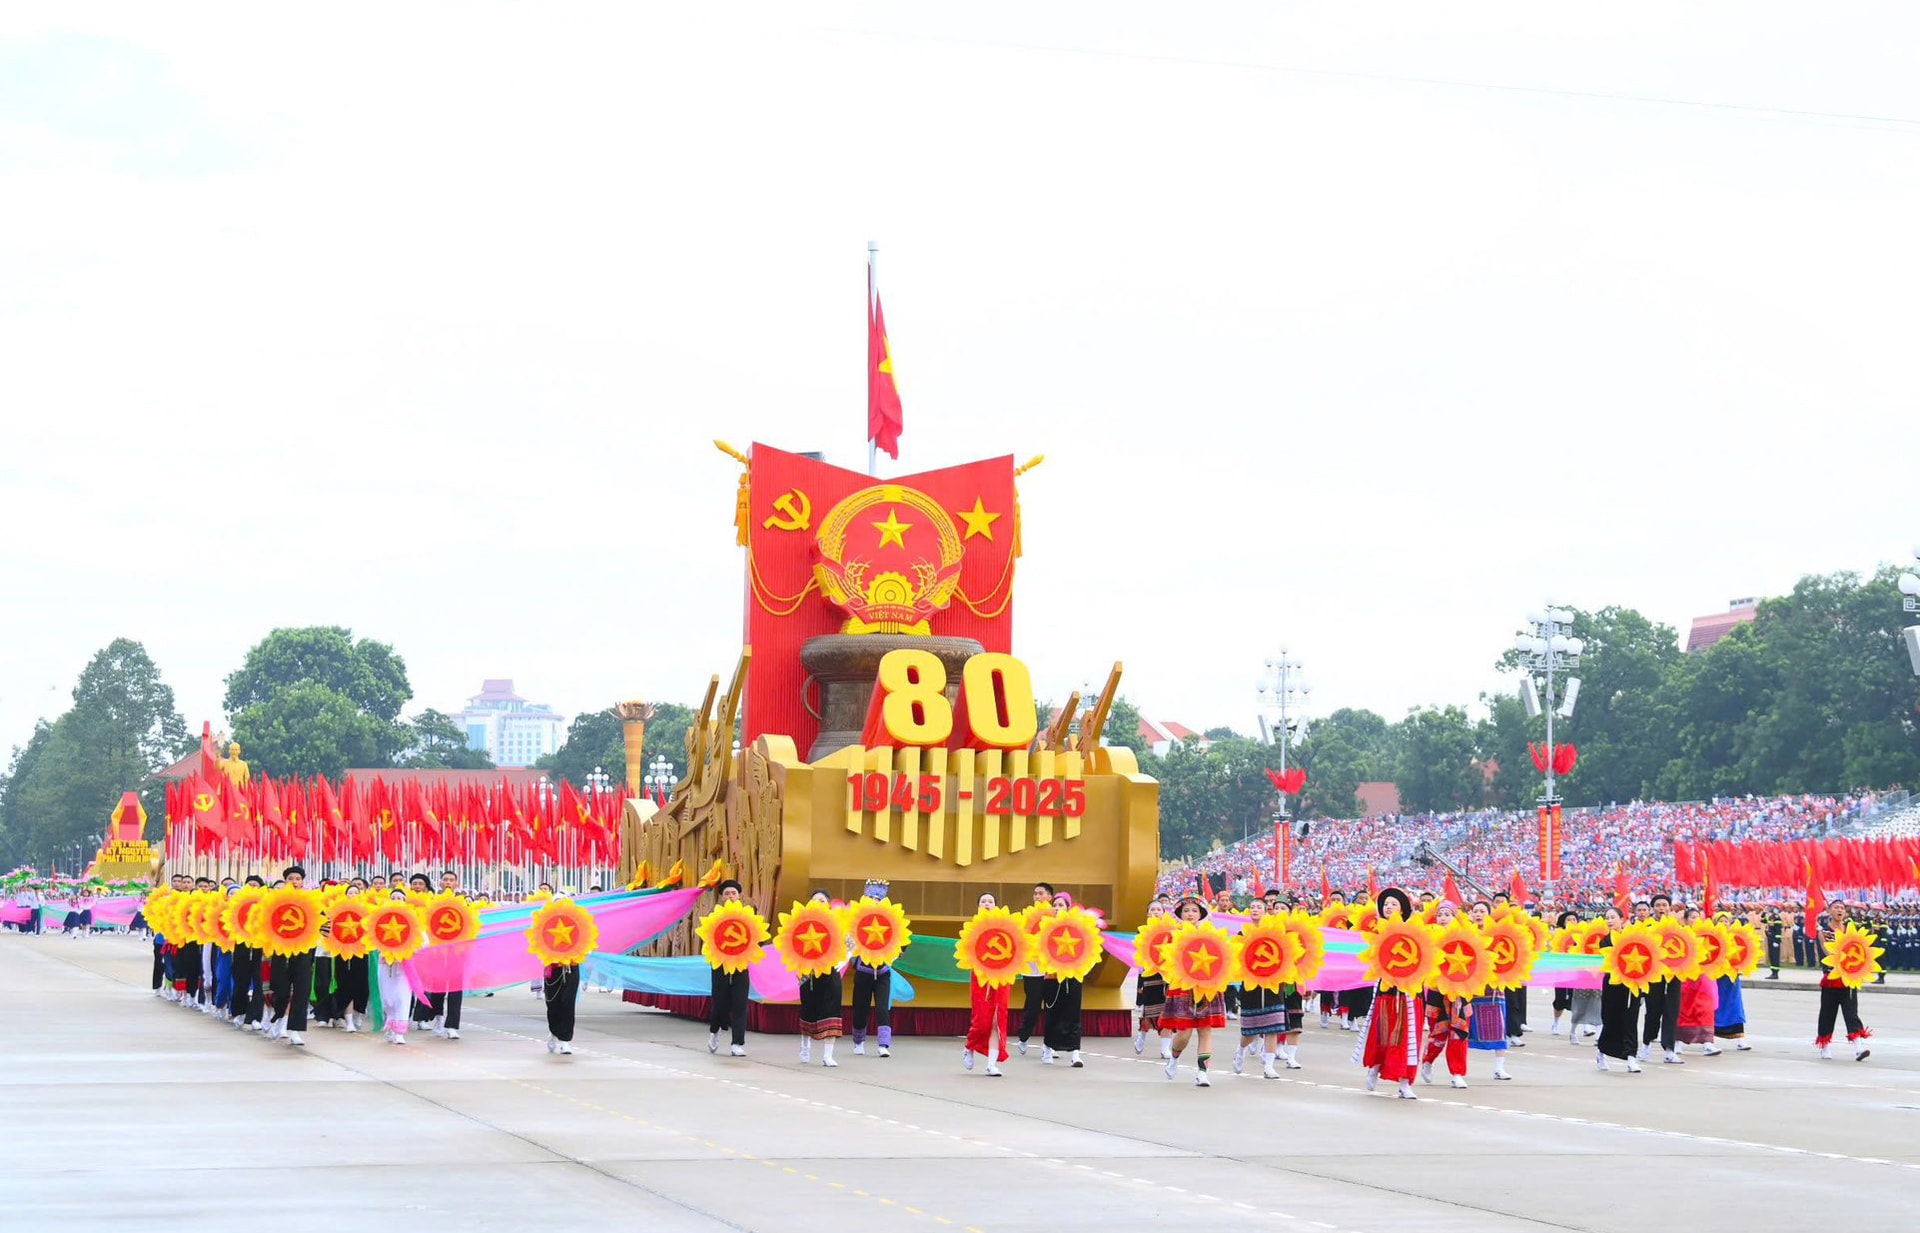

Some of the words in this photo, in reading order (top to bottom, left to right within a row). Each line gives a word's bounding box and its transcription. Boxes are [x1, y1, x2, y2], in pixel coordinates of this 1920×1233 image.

[891, 611, 913, 622] NAM
[879, 649, 1038, 746] 80
[847, 773, 941, 813] 1945
[986, 777, 1087, 817] 2025
